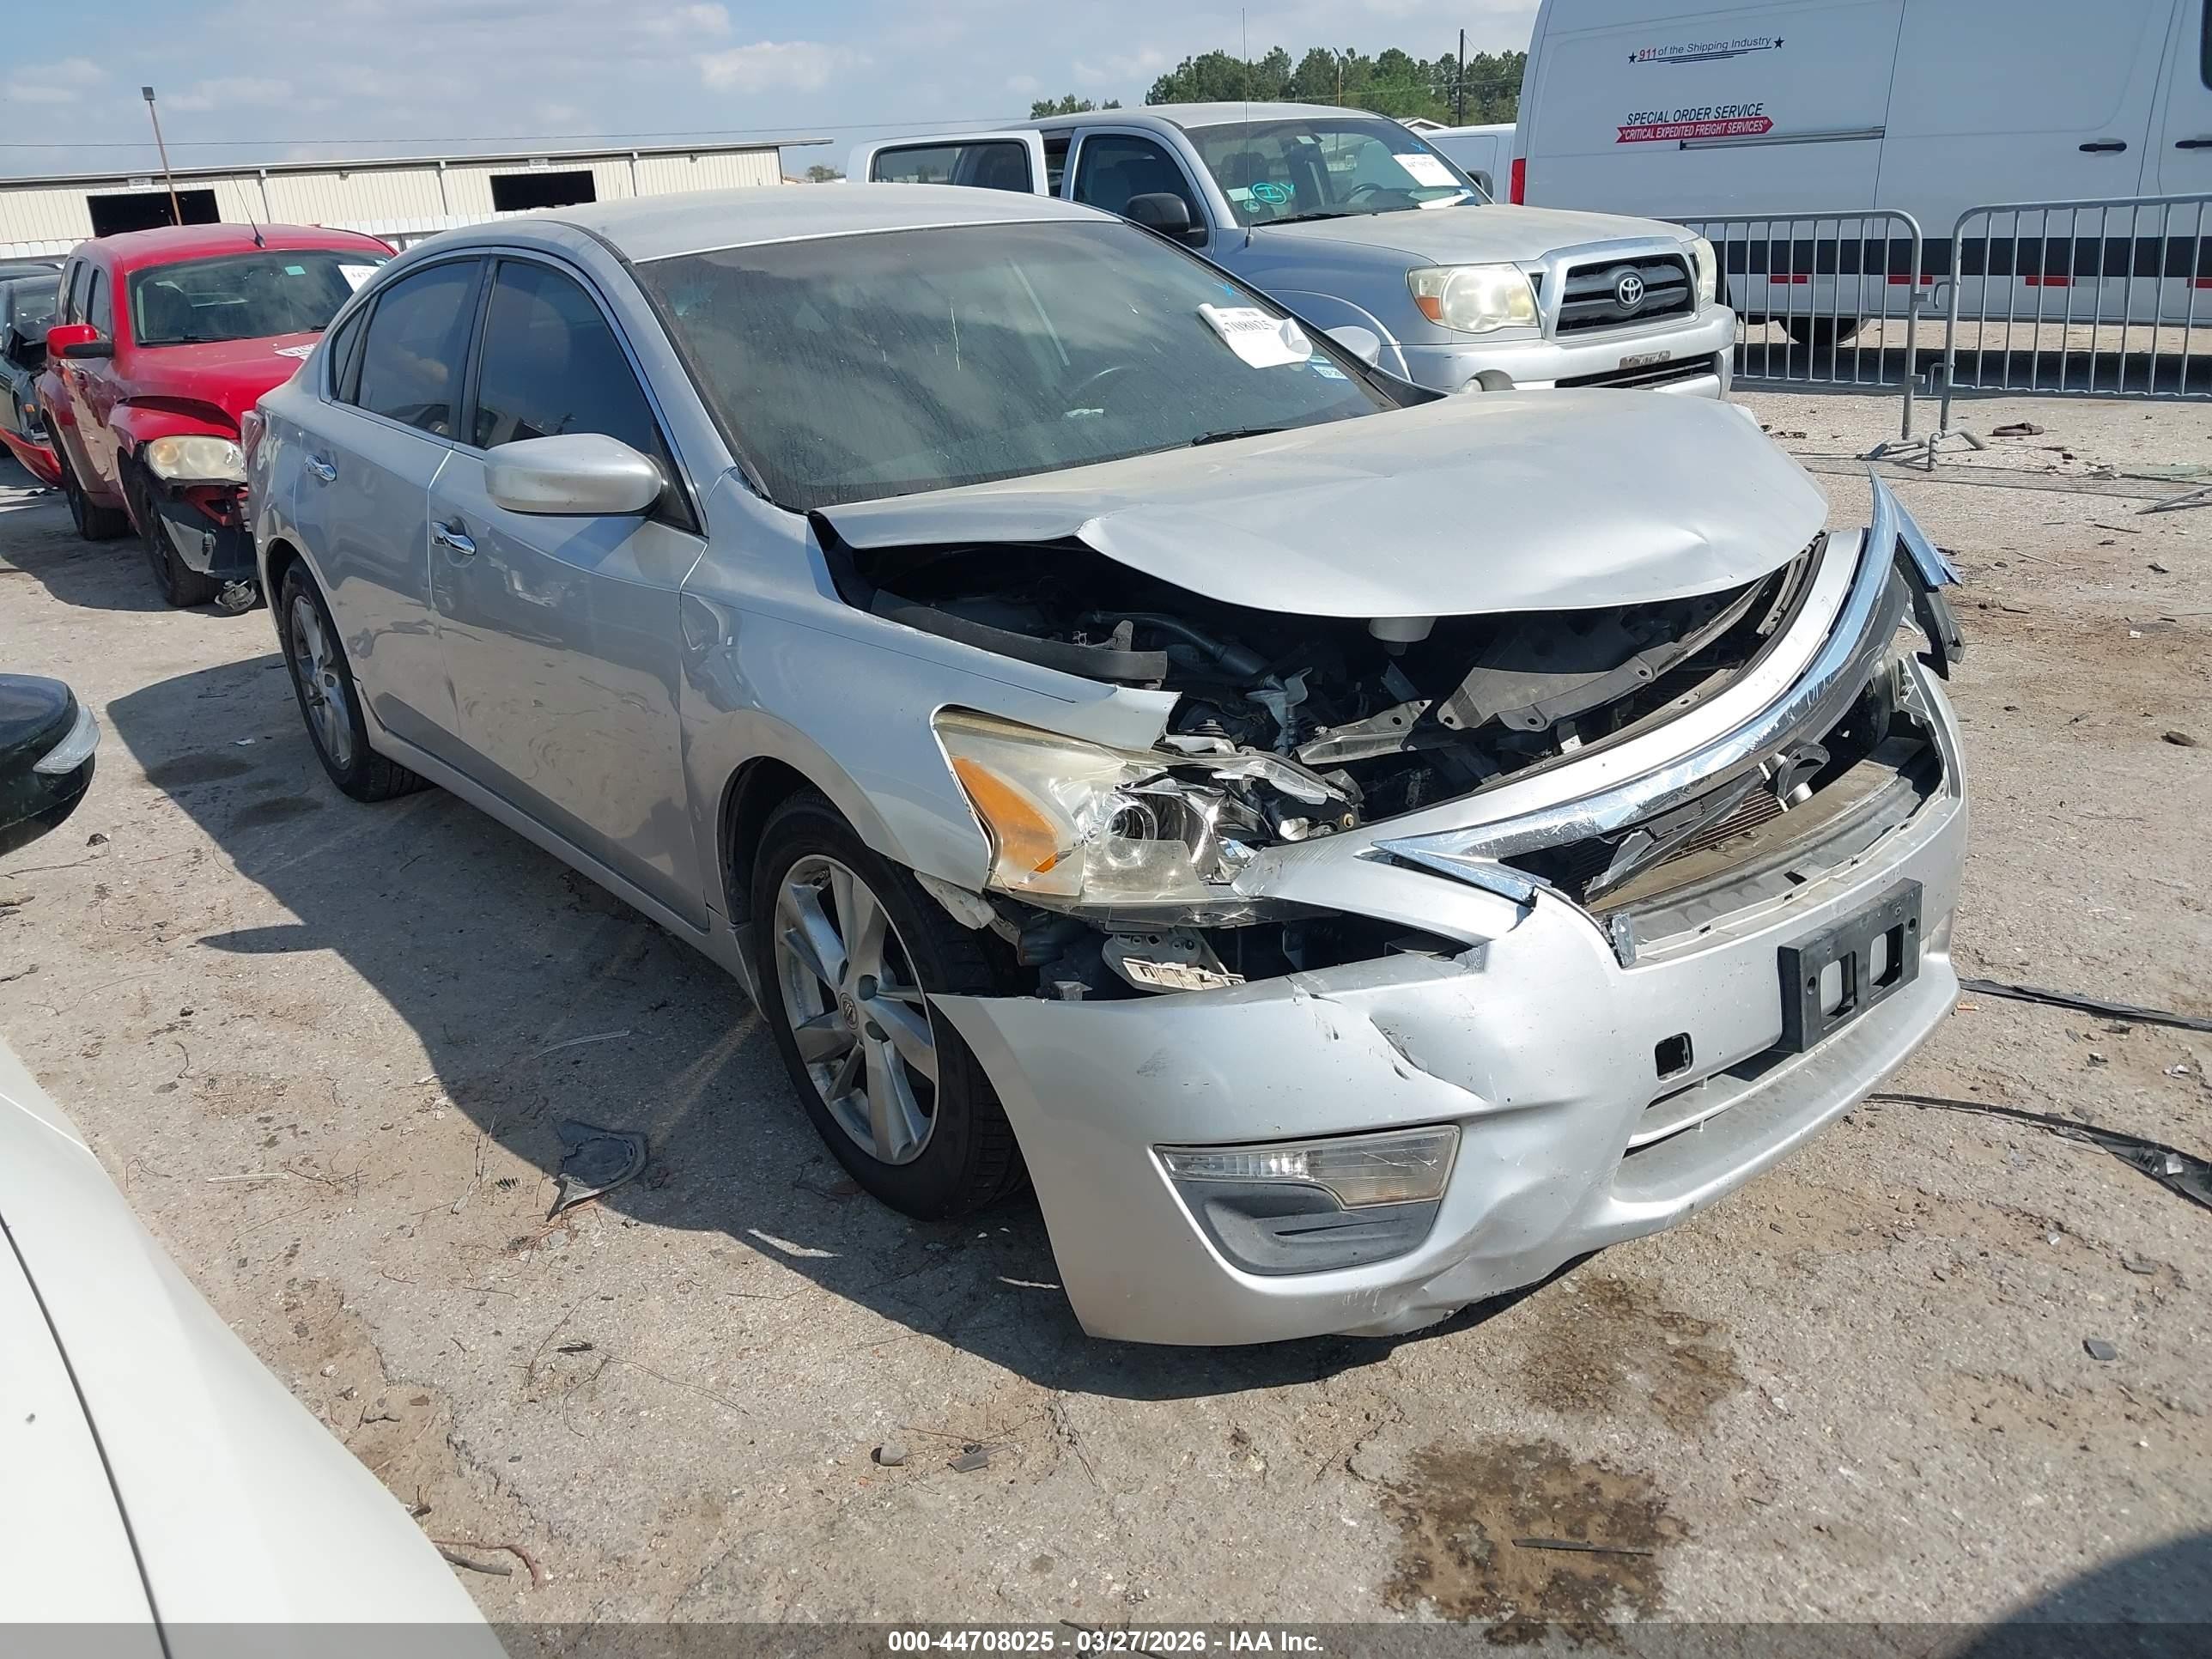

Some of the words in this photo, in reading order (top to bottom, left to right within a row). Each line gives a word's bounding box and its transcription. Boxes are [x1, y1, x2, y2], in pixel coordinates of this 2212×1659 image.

[1638, 48, 1657, 60] 911
[1657, 46, 1668, 56] of
[1669, 45, 1684, 55] the
[1687, 40, 1729, 54] Shipping
[1731, 36, 1771, 49] Industry
[1626, 110, 1669, 125] SPECIAL
[1673, 107, 1711, 122] ORDER
[1714, 103, 1764, 118] SERVICE
[1622, 128, 1655, 140] "CRITICAL
[1656, 125, 1694, 138] EXPEDITED
[1696, 123, 1726, 136] FREIGHT
